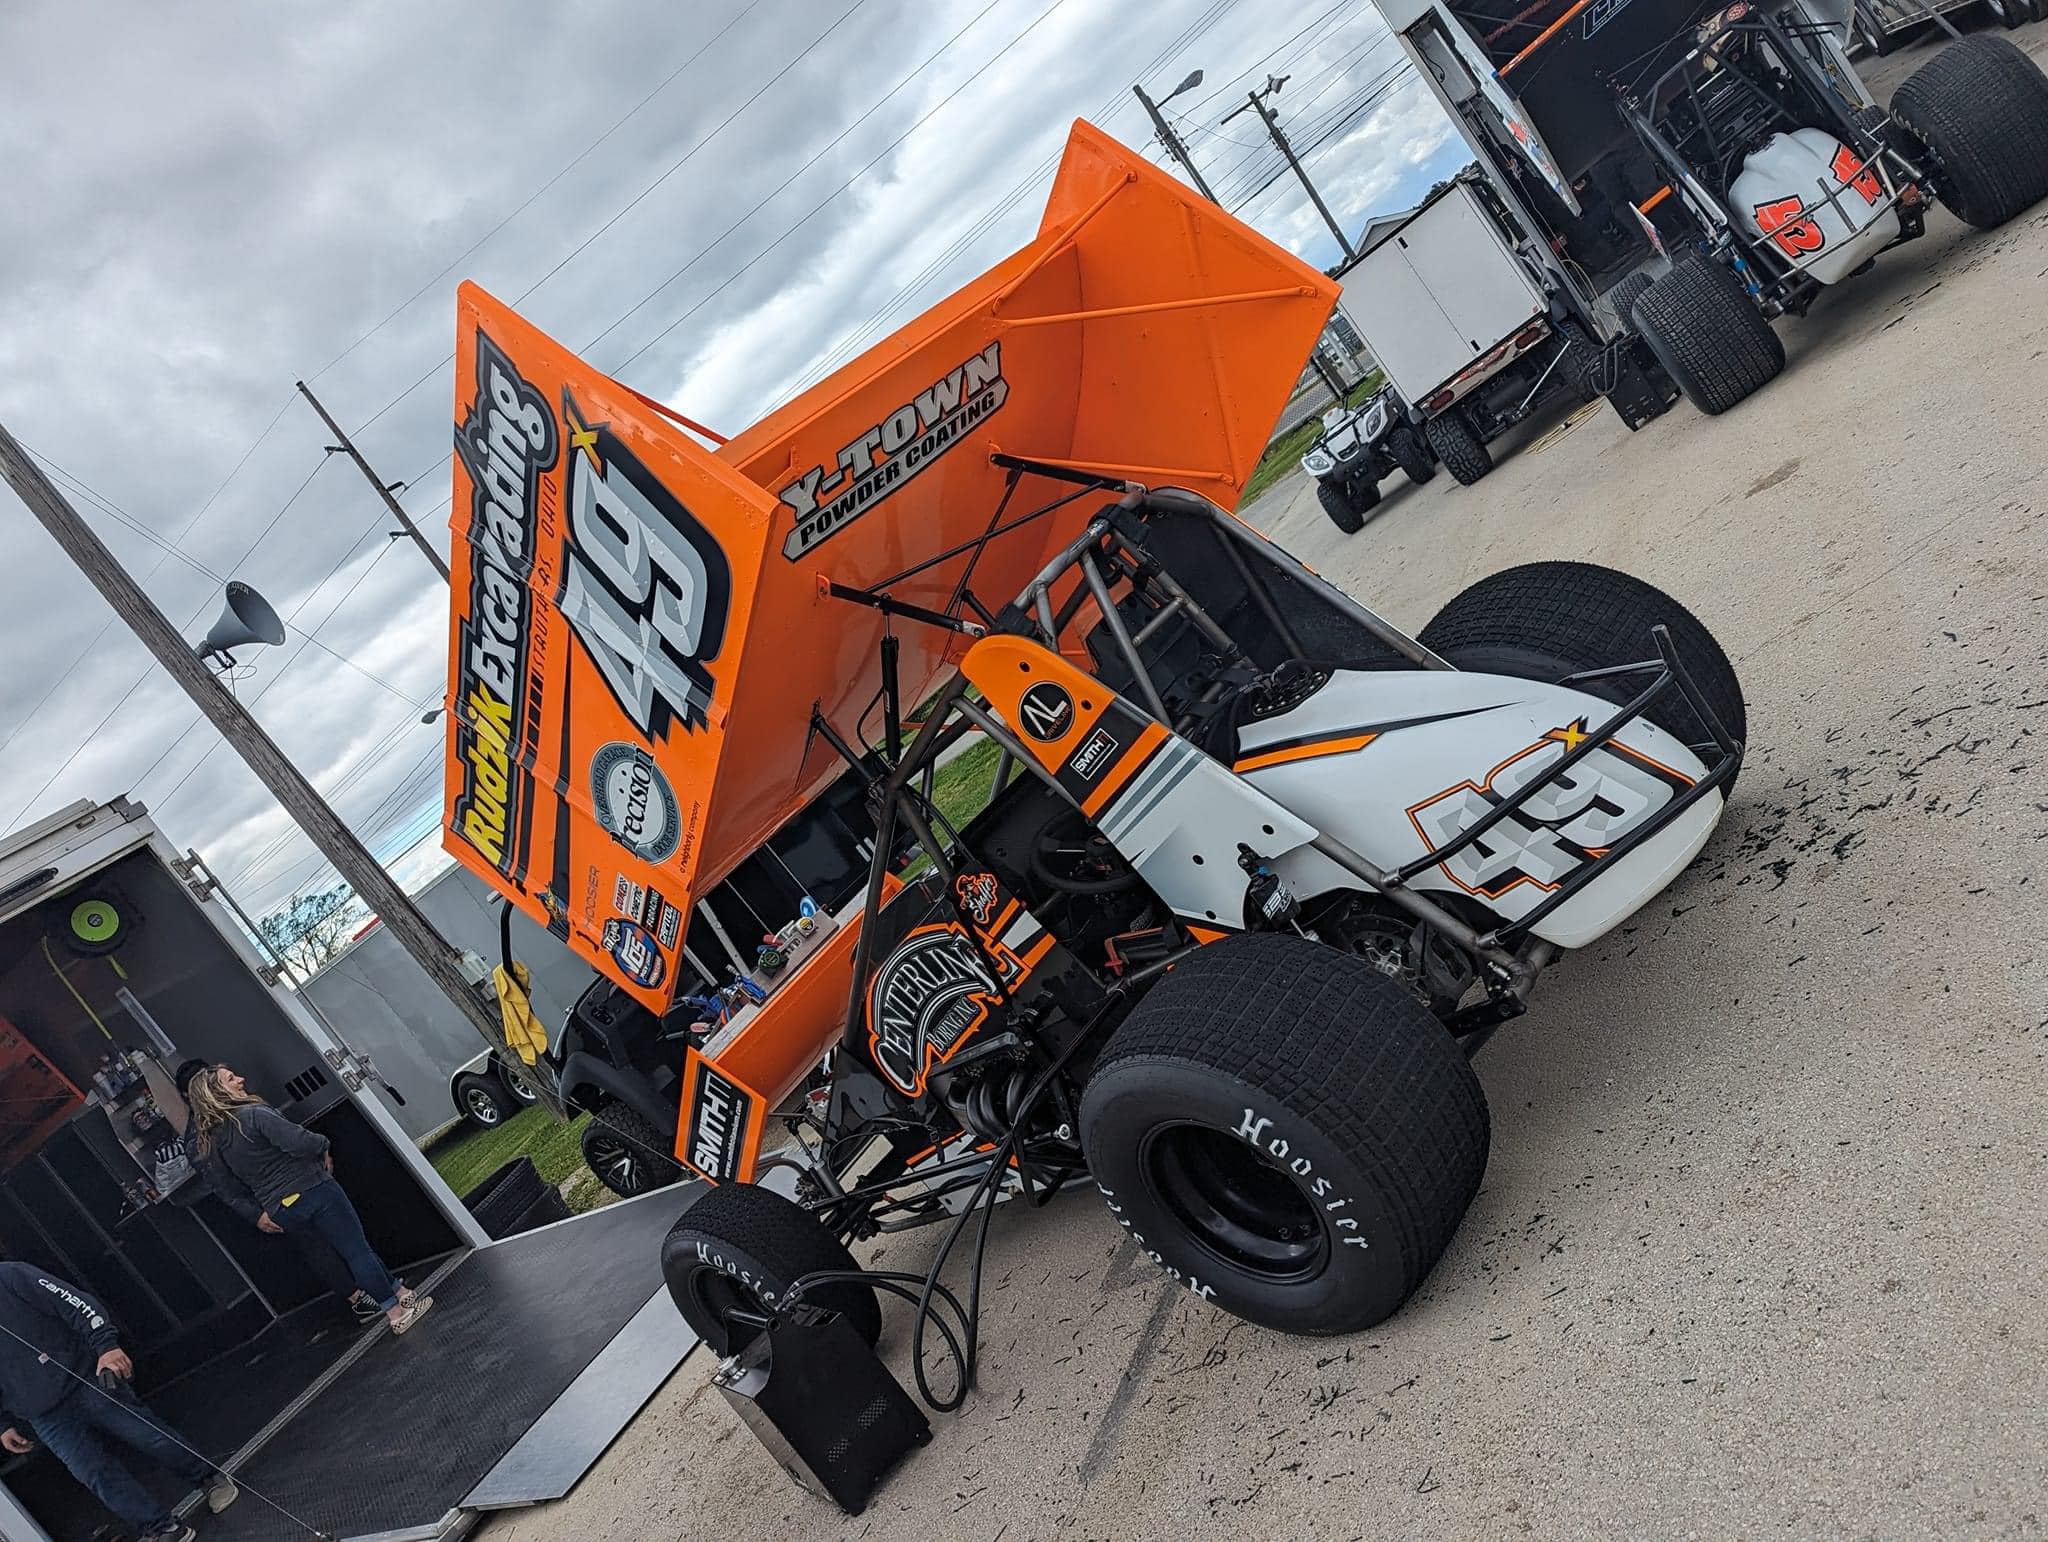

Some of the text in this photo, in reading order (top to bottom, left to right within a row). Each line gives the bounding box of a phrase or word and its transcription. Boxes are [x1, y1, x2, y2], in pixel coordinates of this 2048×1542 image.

[1754, 196, 1823, 258] 15
[779, 339, 1001, 522] Y-TOWN
[801, 392, 994, 547] POWDER COATING
[541, 475, 557, 538] OHIO
[464, 362, 544, 867] Rudzik Excavating
[596, 747, 629, 825] OVERHEAD GARAGE
[610, 746, 655, 859] Precision
[652, 795, 677, 856] DOOR SERVICE
[583, 865, 599, 930] HOOSIER
[660, 905, 674, 943] CAPITOL
[926, 1012, 965, 1052] BORING
[1231, 1108, 1369, 1249] Hoosier
[38, 1278, 96, 1319] carhartt
